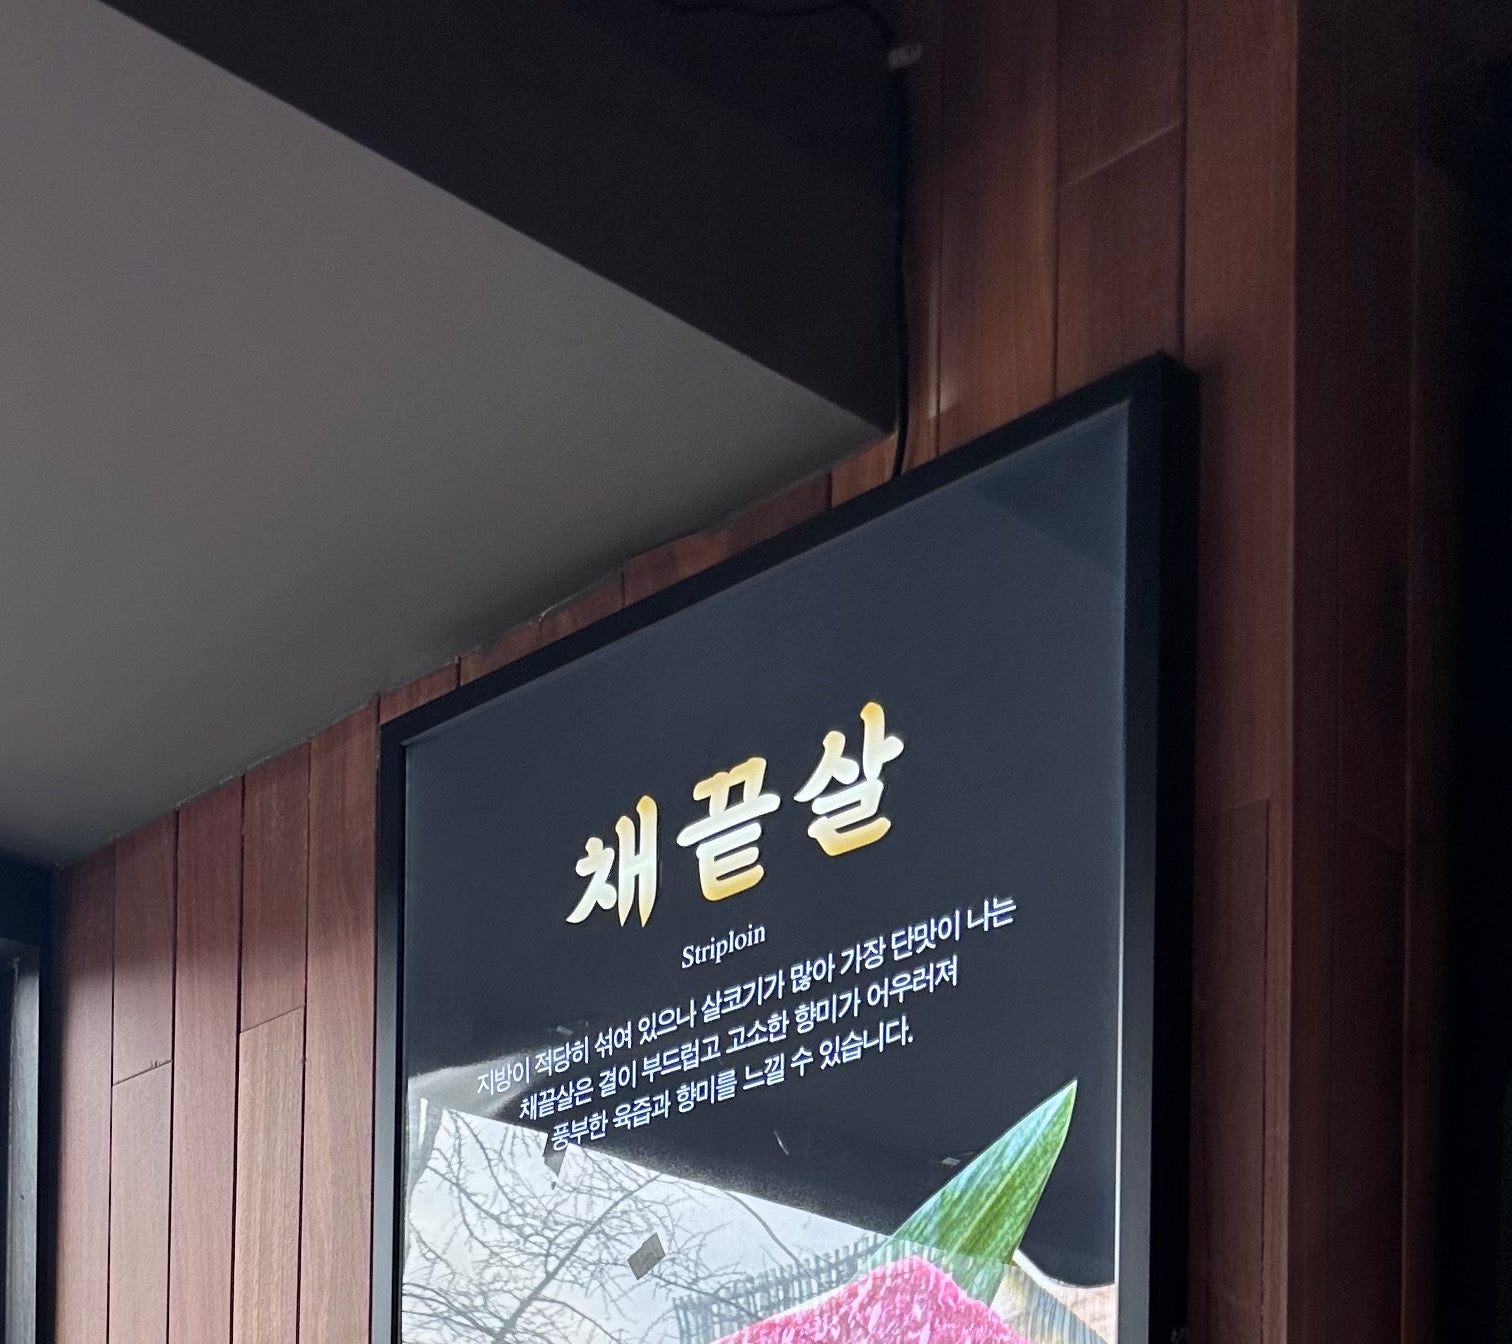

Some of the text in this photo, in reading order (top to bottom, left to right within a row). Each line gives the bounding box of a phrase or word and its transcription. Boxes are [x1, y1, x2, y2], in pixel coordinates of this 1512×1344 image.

[565, 700, 905, 928] 채끝살
[476, 896, 1017, 1096] 지방이 적당히 섞여 있으나 살코기가 많아 가장 단맛이 나는
[681, 923, 767, 970] Striploin
[519, 954, 958, 1121] 채끝살은 결이 부드럽고 고소한 향미가 어우러져
[550, 1014, 914, 1151] 풍부한 육즙과 향미를 느낄 수 있습니다.
